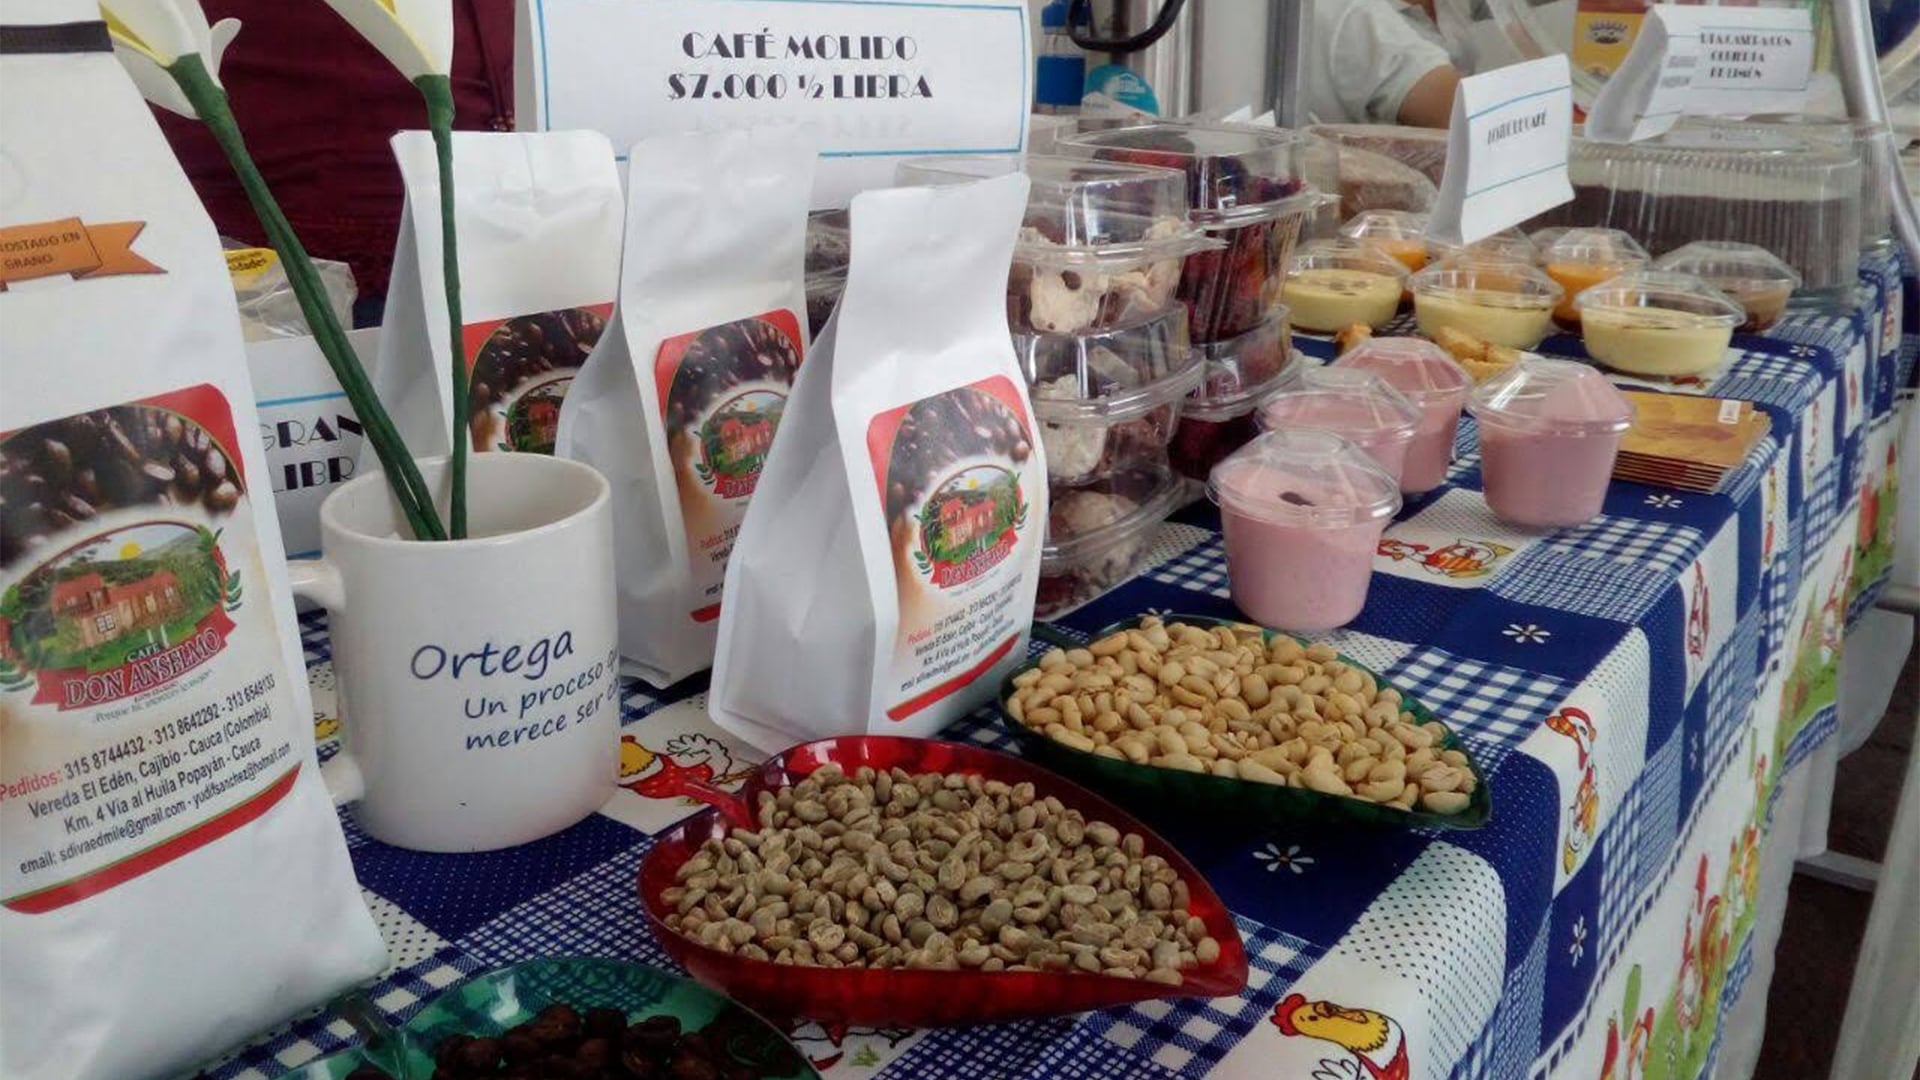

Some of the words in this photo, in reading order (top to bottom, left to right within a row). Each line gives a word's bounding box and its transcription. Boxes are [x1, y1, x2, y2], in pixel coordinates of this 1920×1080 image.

[682, 27, 777, 59] CAFÉ
[785, 34, 918, 61] MOLIDO
[668, 72, 787, 100] $7.000
[833, 73, 933, 99] LIBRA
[4, 253, 54, 270] GRANO
[62, 231, 81, 245] EN
[64, 667, 125, 708] DON
[129, 627, 220, 692] ANSELMO
[411, 630, 574, 681] Ortega
[464, 696, 508, 720] Un
[519, 660, 604, 720] proceso
[64, 757, 90, 779] 315
[92, 735, 147, 770] 8744432
[153, 723, 176, 745] 313
[176, 703, 220, 735] 8642292
[226, 690, 244, 712] 313
[465, 713, 568, 750] merece
[575, 693, 605, 724] ser
[28, 790, 80, 818] Vereda
[81, 780, 98, 801] El
[188, 731, 223, 756] Cauca
[223, 701, 272, 743] (Colombia)
[64, 815, 94, 835] Km.
[96, 804, 105, 821] 4
[131, 788, 144, 809] al
[144, 779, 177, 803] Huila
[231, 737, 262, 761] Cauca
[20, 850, 58, 875] email:
